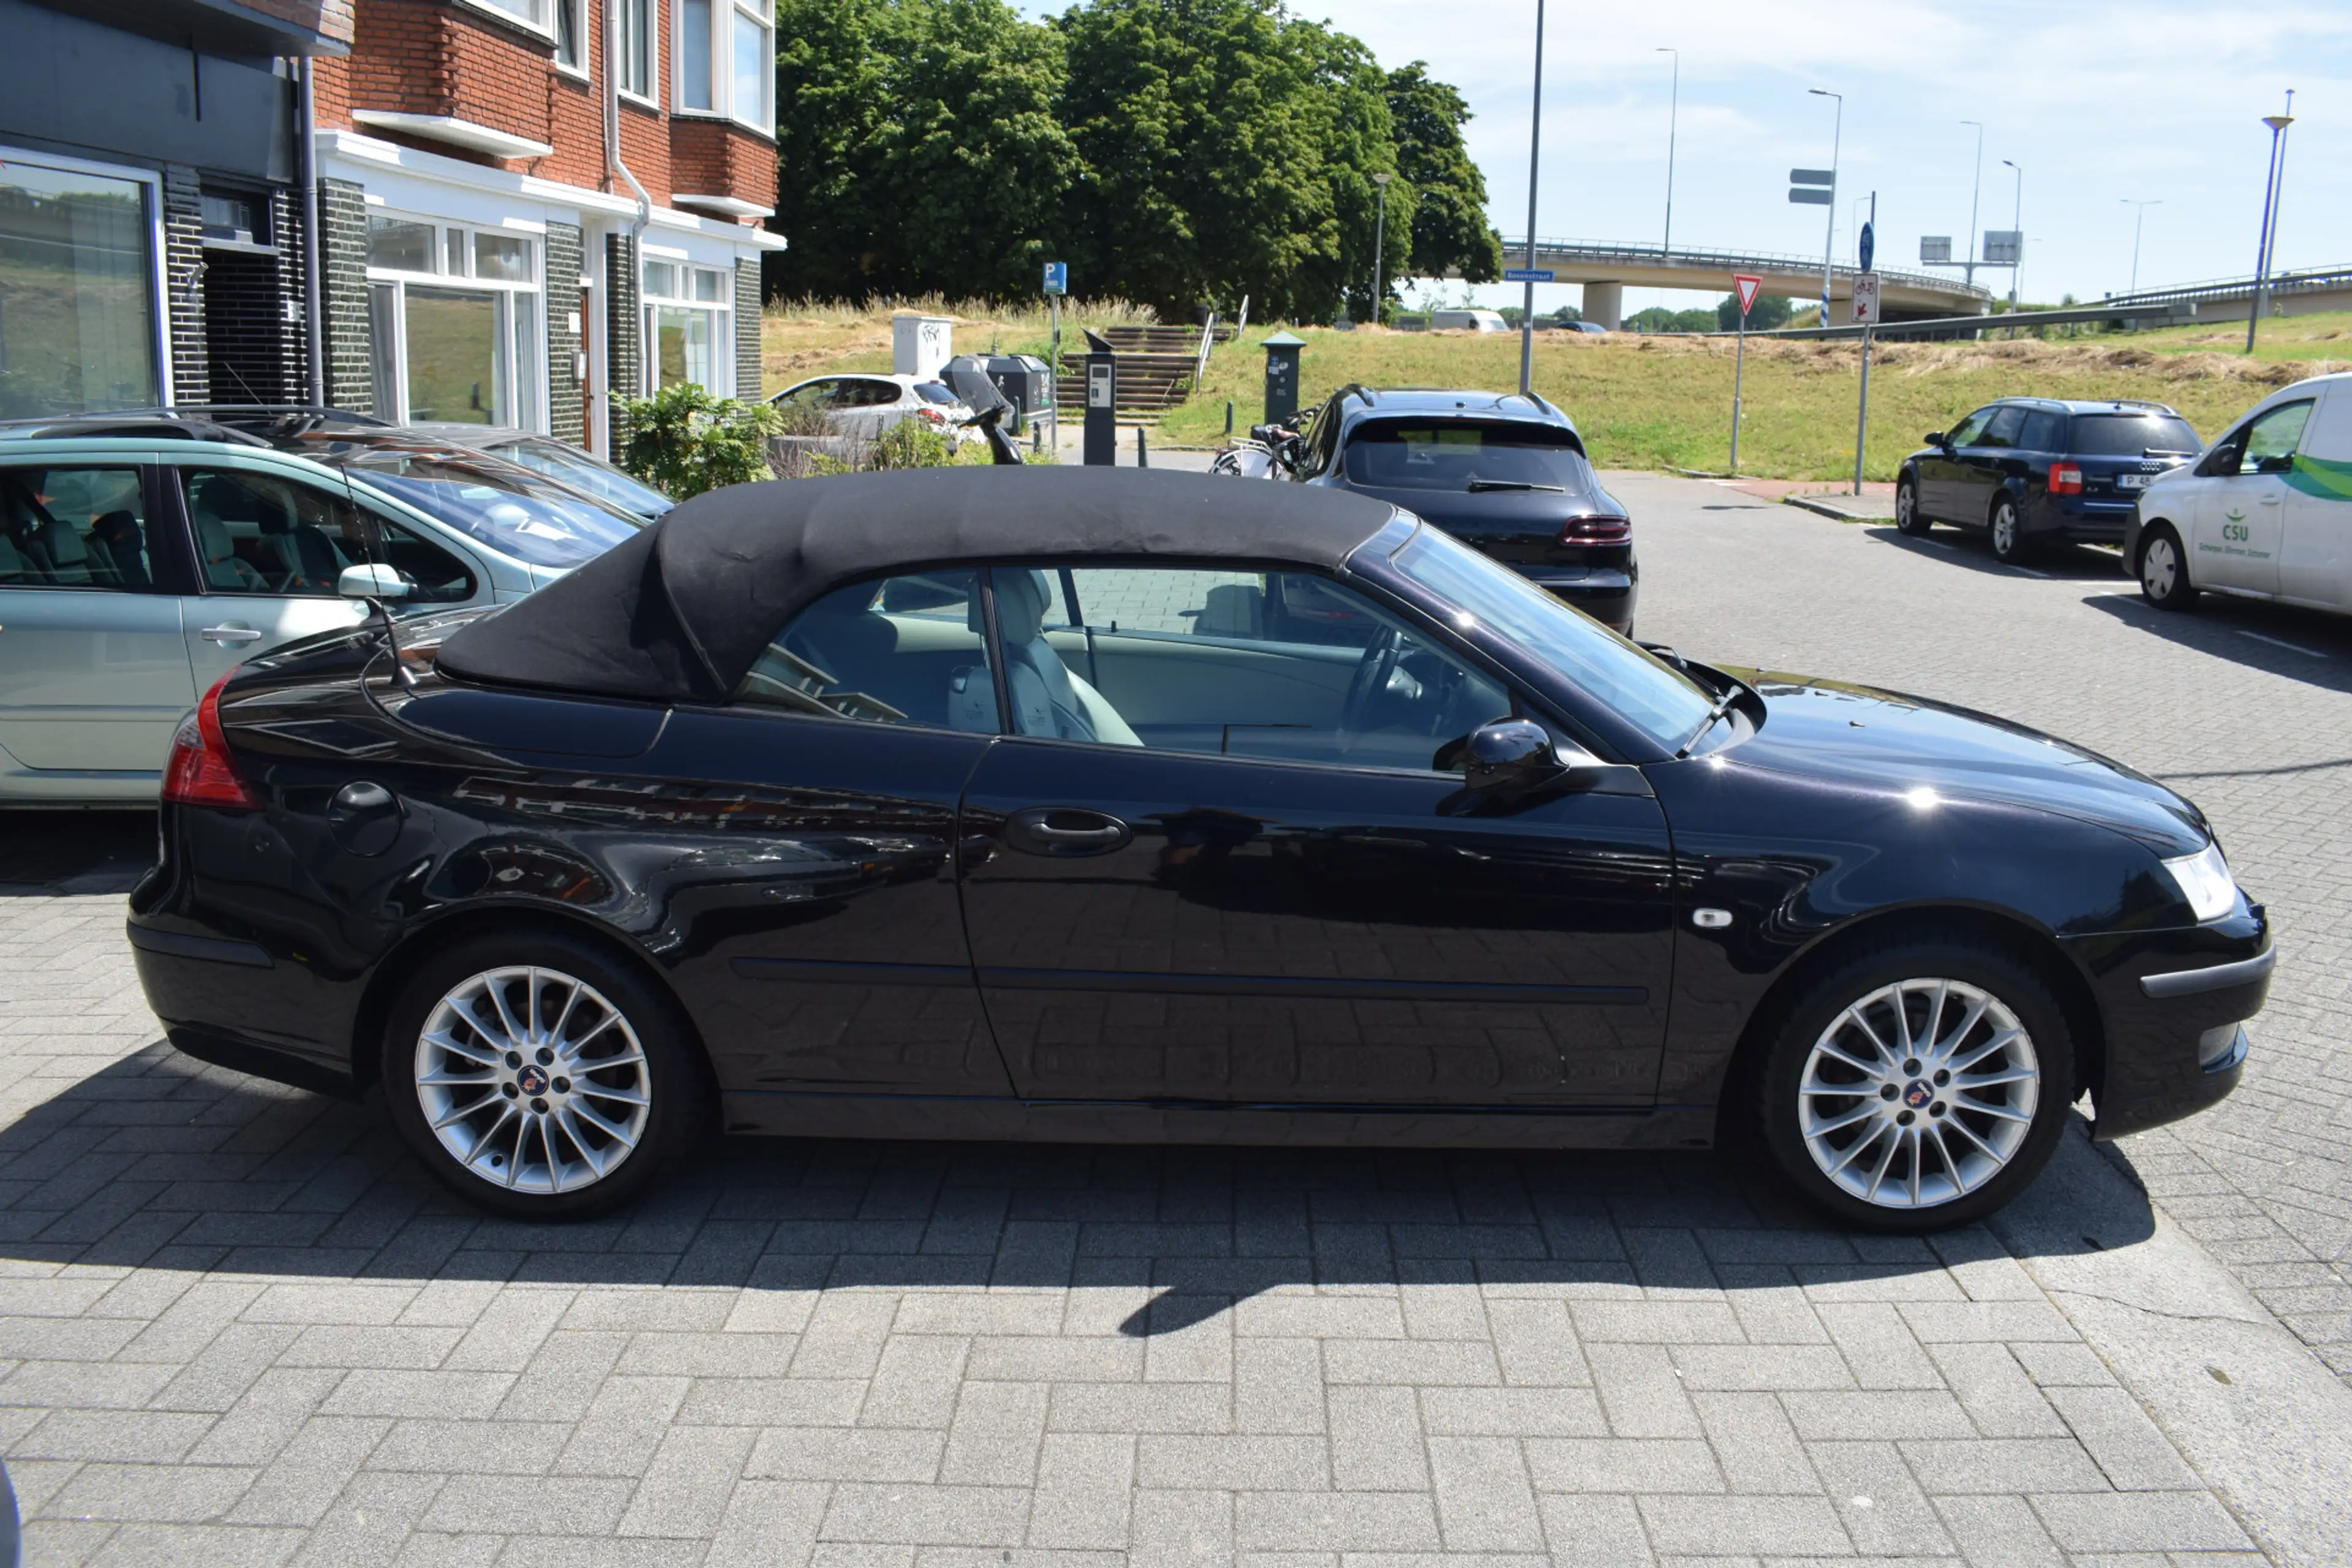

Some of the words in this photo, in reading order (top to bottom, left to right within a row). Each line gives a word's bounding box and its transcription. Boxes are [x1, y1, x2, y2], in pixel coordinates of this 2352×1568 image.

[1046, 263, 1055, 278] P
[2127, 477, 2133, 486] P
[2223, 524, 2248, 542] CSU
